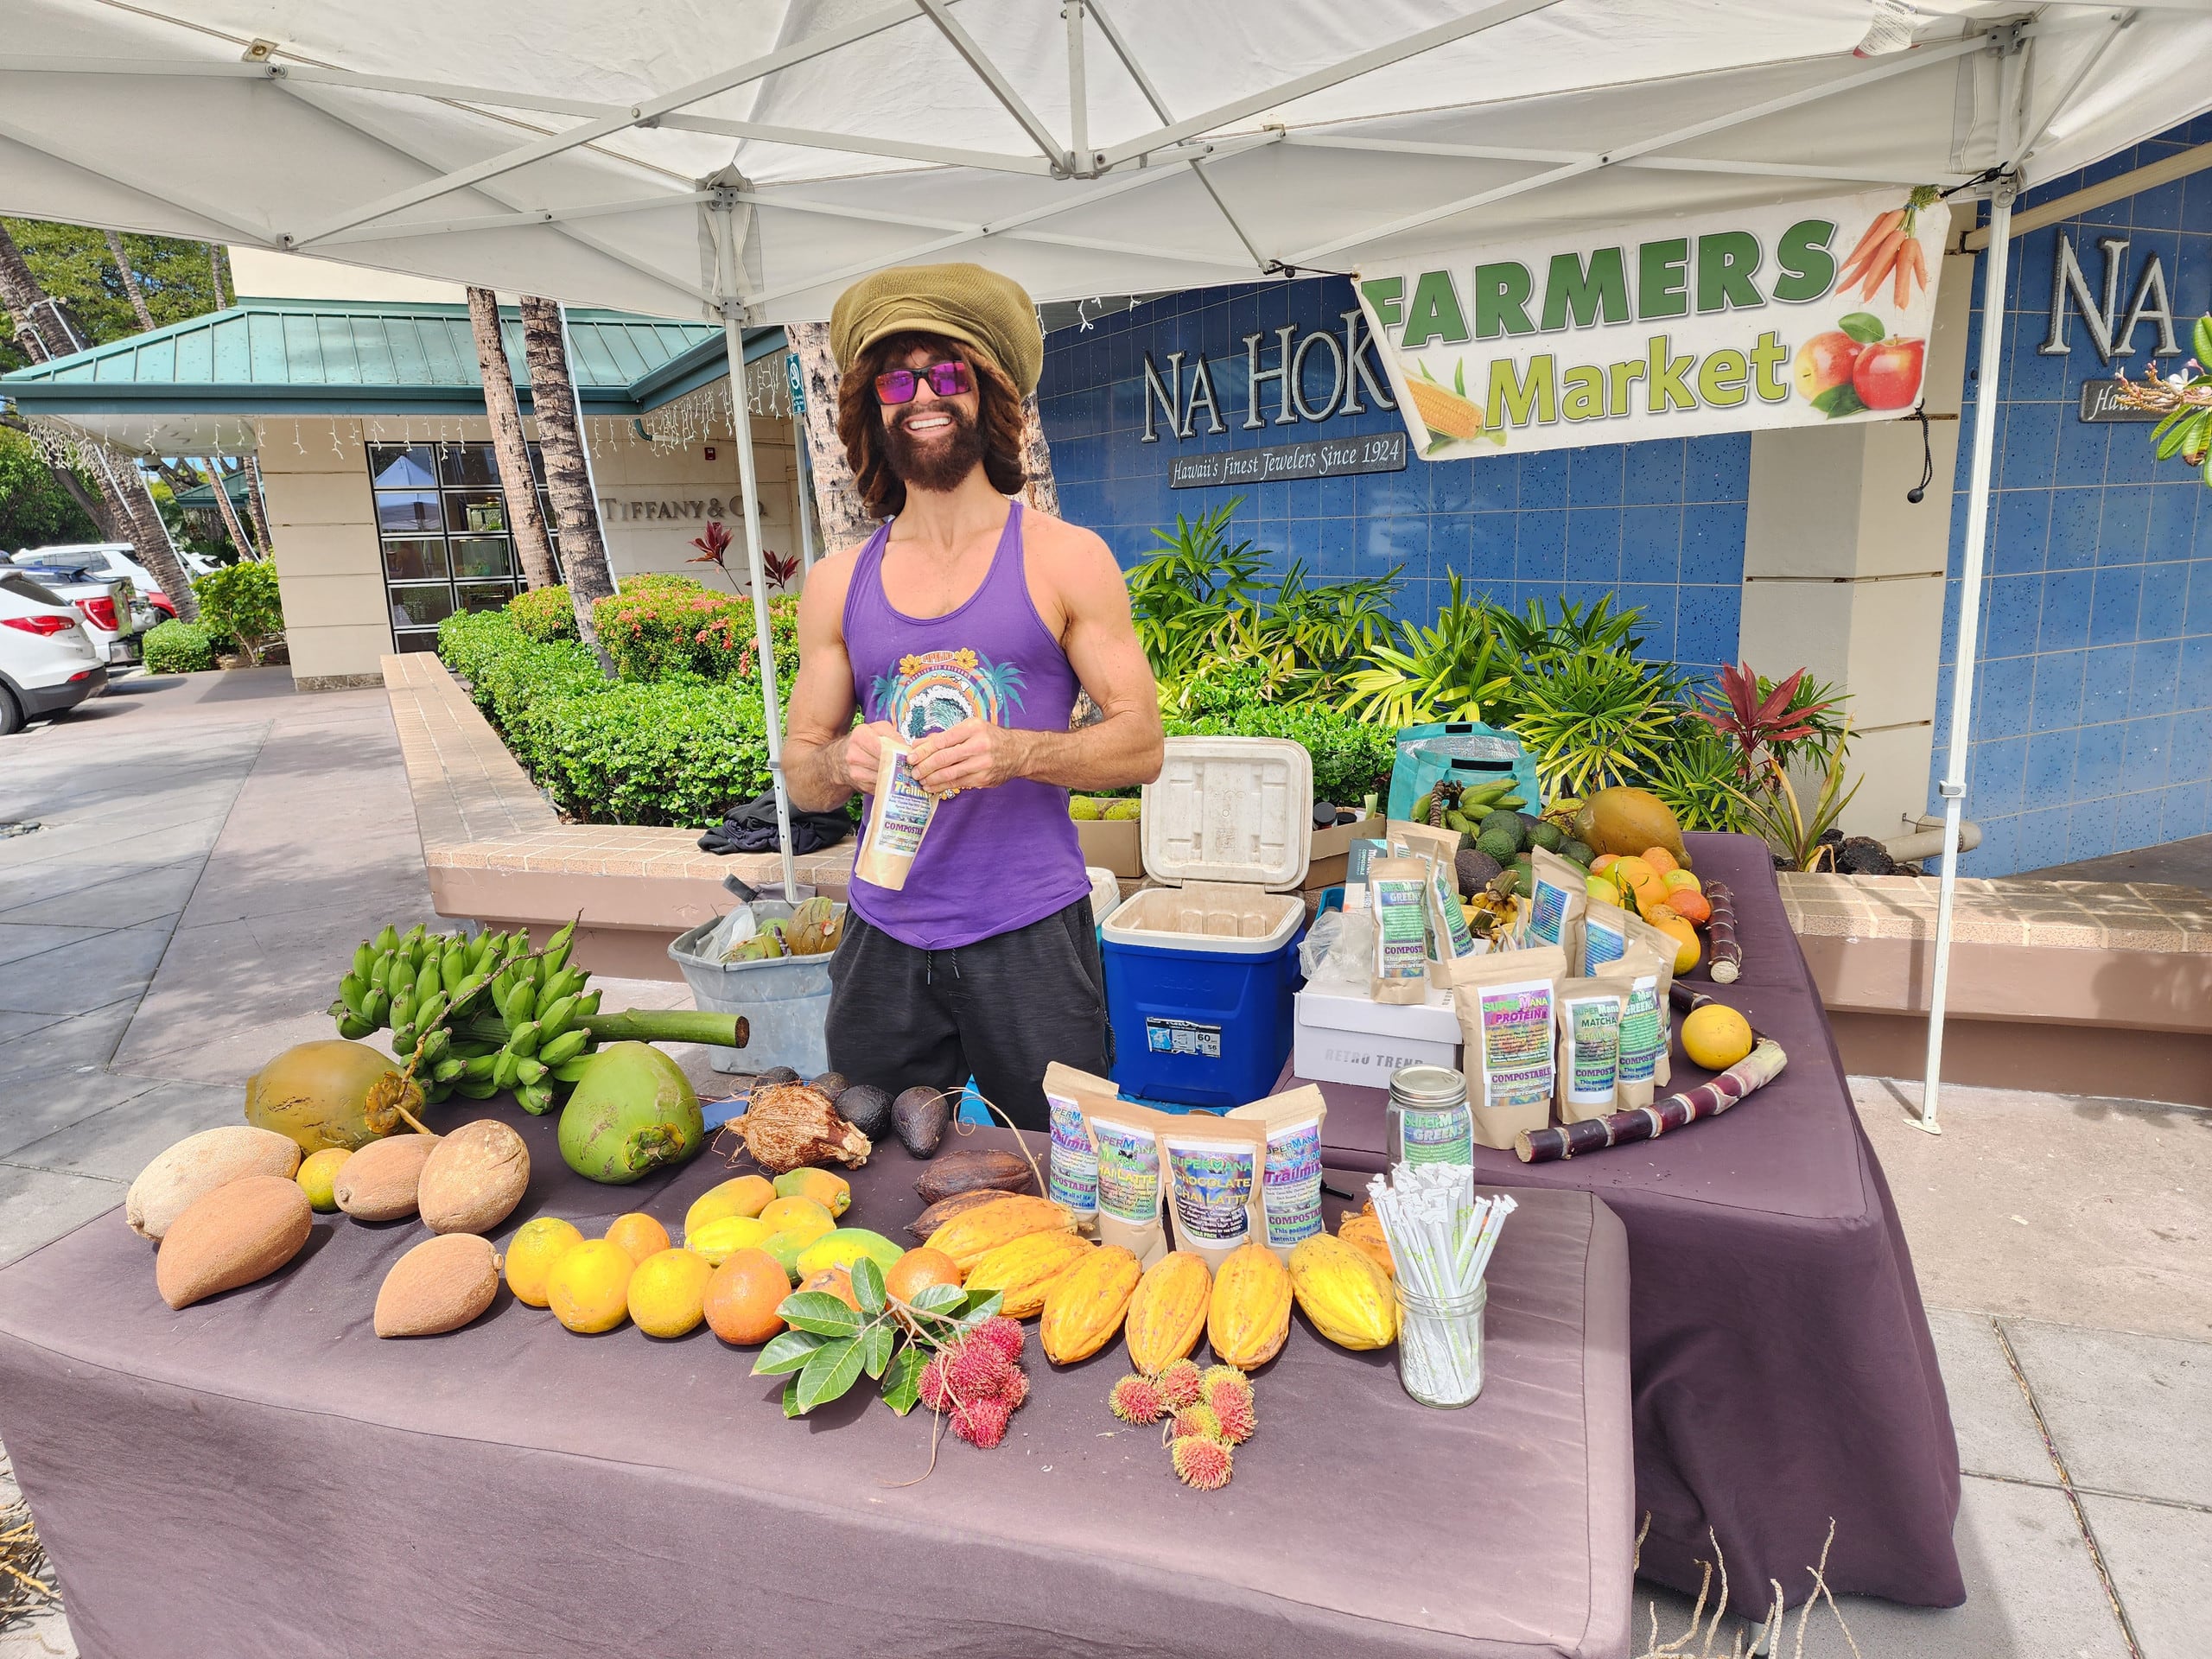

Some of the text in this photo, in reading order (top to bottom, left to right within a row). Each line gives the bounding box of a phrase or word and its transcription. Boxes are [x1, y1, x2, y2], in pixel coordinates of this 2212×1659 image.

[1362, 219, 1837, 348] FARMERS
[2037, 228, 2182, 366] NA
[1484, 331, 1789, 429] Market
[1141, 350, 1227, 443] NA
[1173, 438, 1400, 486] Hawaii's Finest Jewelers Since 1924
[599, 498, 702, 519] TIFFANY
[707, 498, 724, 518] &
[1581, 1018, 1617, 1027] MATCHA
[1198, 1033, 1211, 1042] 60
[1491, 1067, 1552, 1084] COMPOSTABLE
[1117, 1168, 1156, 1186] LATTE
[1174, 1170, 1251, 1188] CHOCOLATE
[1265, 1161, 1321, 1183] Trailmix
[1206, 1194, 1249, 1205] LATTE
